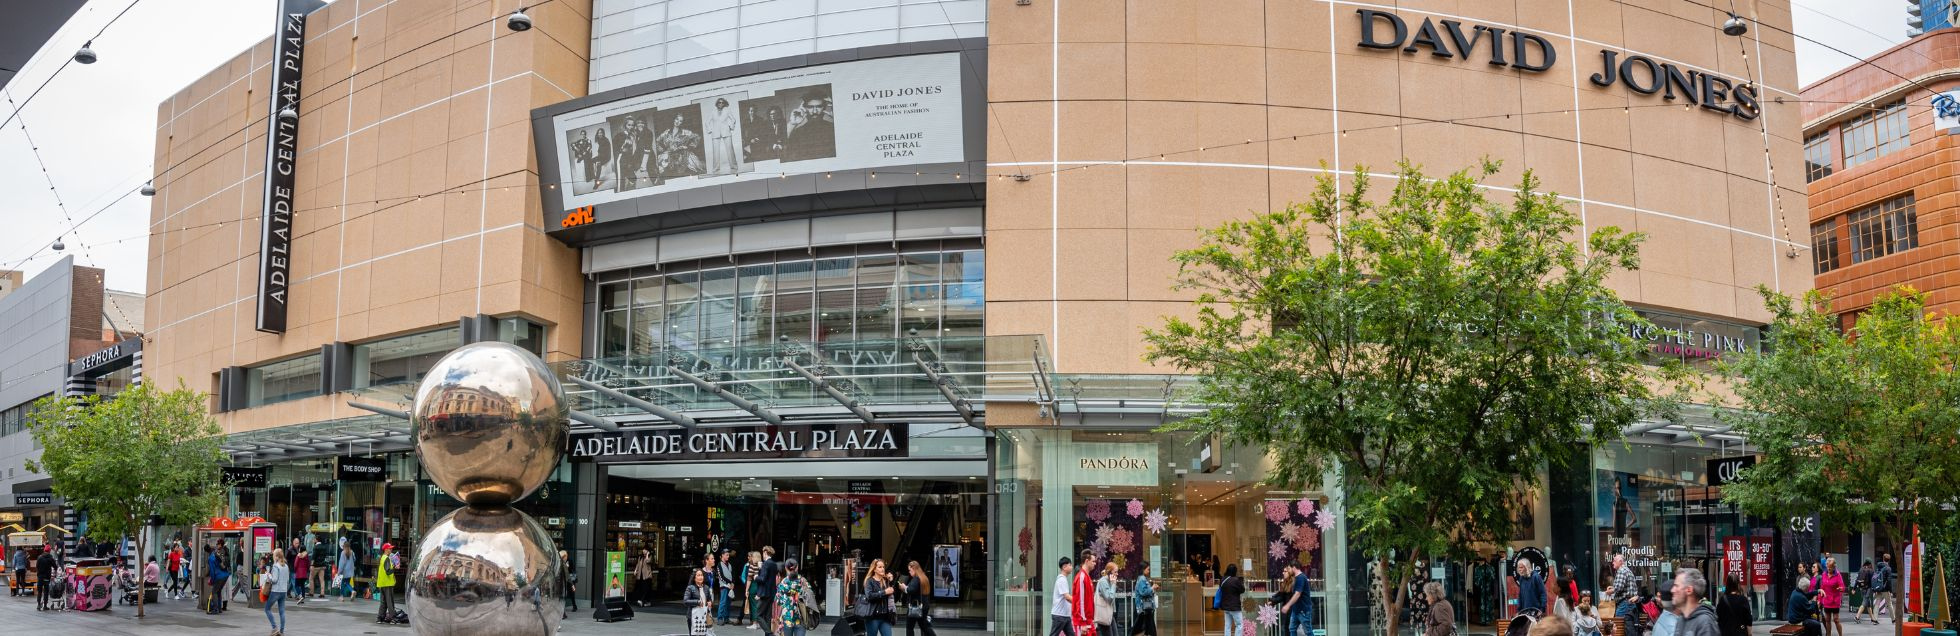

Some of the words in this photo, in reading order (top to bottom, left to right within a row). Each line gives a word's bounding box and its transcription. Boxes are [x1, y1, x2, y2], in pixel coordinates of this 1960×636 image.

[284, 12, 303, 73] PLAZA
[1356, 8, 1557, 72] DAVID
[1589, 48, 1761, 121] JONES
[852, 89, 894, 101] DAVID
[896, 85, 942, 97] JONES
[864, 110, 902, 118] AUSTRALIAN
[903, 107, 930, 115] FASHION
[277, 80, 298, 176] CENTAL
[874, 131, 924, 142] ADELAIDE
[876, 141, 921, 151] CENTRAL
[883, 149, 914, 158] PLAZA
[271, 185, 291, 305] ADELAIDE
[1704, 332, 1746, 353] PINK
[81, 345, 119, 370] SEPHORA
[1648, 343, 1720, 359] IAMONDS
[572, 434, 682, 457] ADELAIDE
[688, 431, 803, 453] CENTRAL
[811, 428, 898, 451] PLAZA
[343, 464, 354, 472] THE
[353, 465, 367, 473] BODY
[1080, 455, 1149, 469] PANDÓRA
[1790, 516, 1814, 533] CUE
[1608, 533, 1632, 547] Proudly
[1729, 540, 1741, 550] IT'S
[1621, 545, 1654, 557] Proudly
[1726, 551, 1744, 561] YOUR
[1756, 553, 1767, 563] OFF
[1625, 557, 1659, 567] stralian
[1729, 561, 1742, 571] CUE
